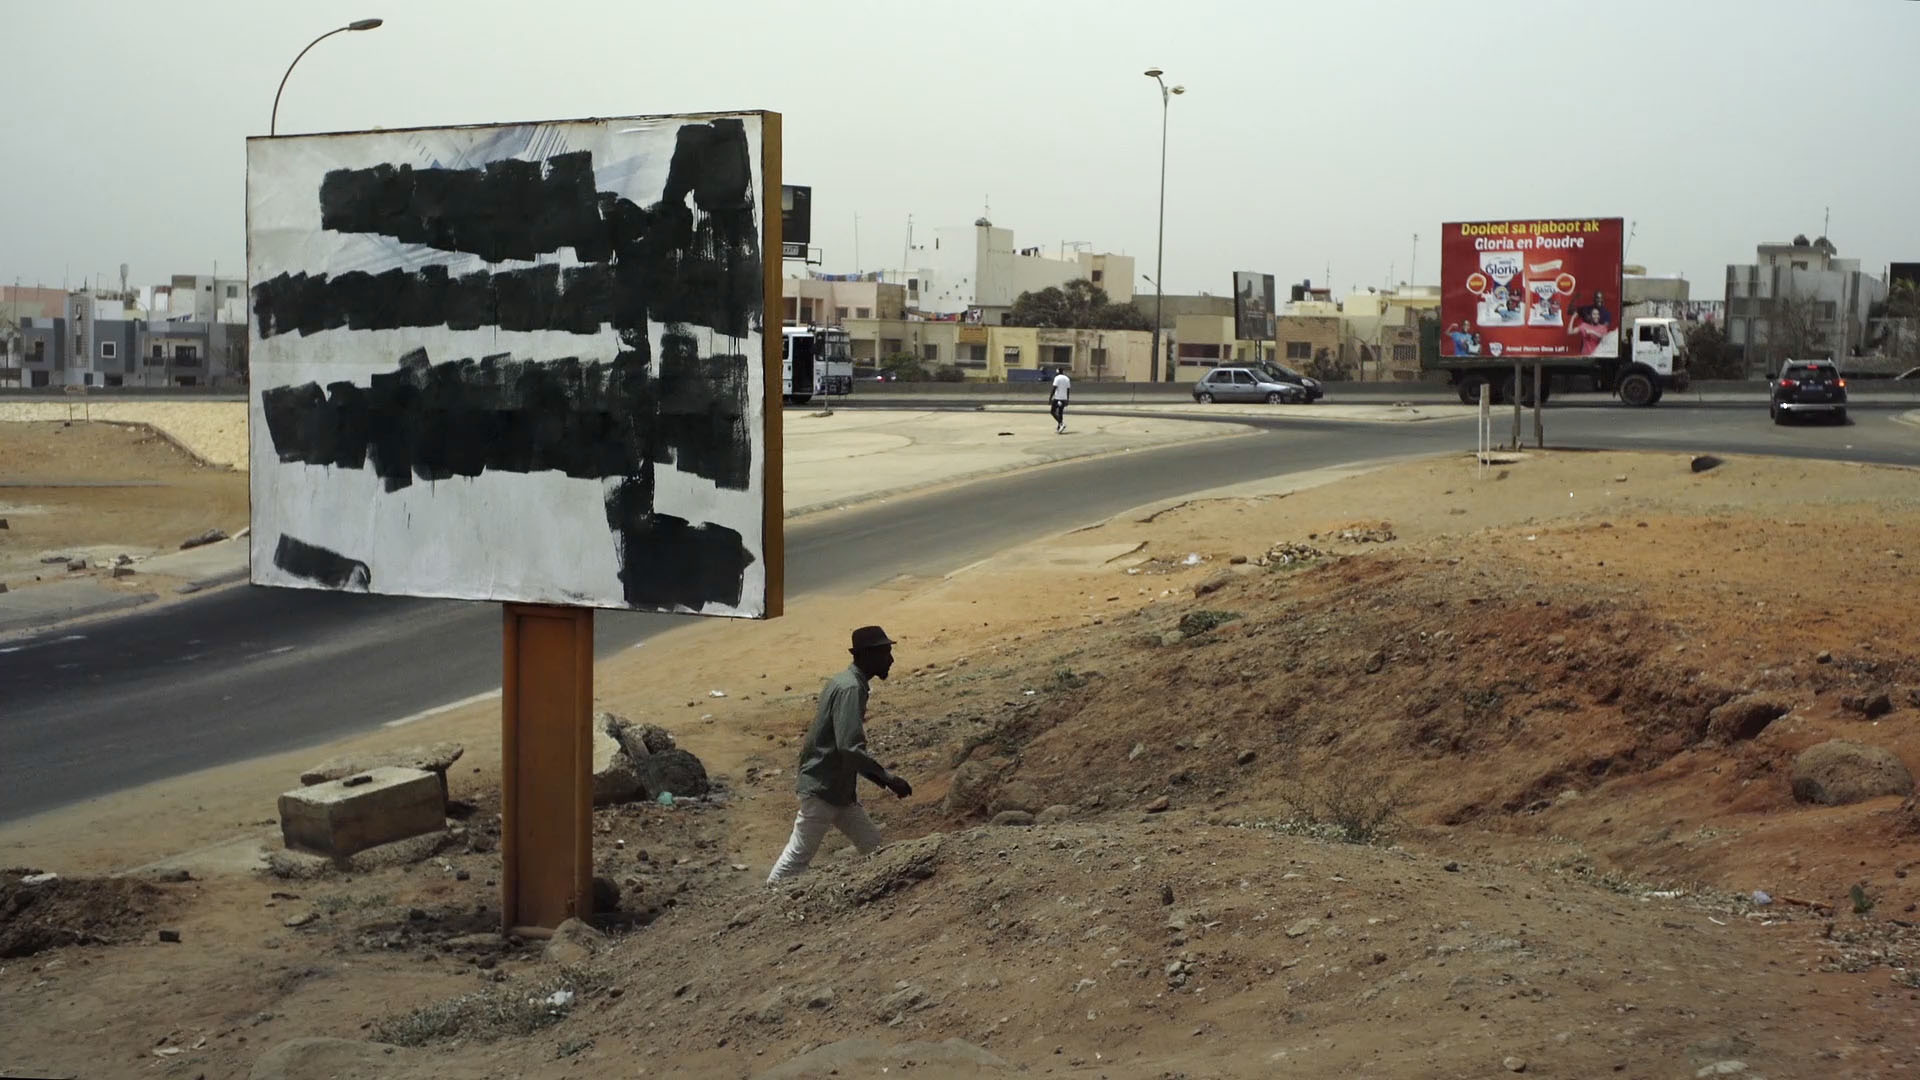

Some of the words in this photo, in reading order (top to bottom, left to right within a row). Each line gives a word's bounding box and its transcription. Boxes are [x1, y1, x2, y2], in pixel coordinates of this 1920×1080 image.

[1461, 222, 1510, 236] Dooleel
[1512, 224, 1527, 235] sa
[1529, 220, 1581, 236] njaboot
[1583, 220, 1600, 232] ak
[1475, 236, 1514, 250] Gloria
[1517, 238, 1533, 249] en
[1536, 235, 1585, 249] Poudre
[1485, 263, 1519, 275] Gloria
